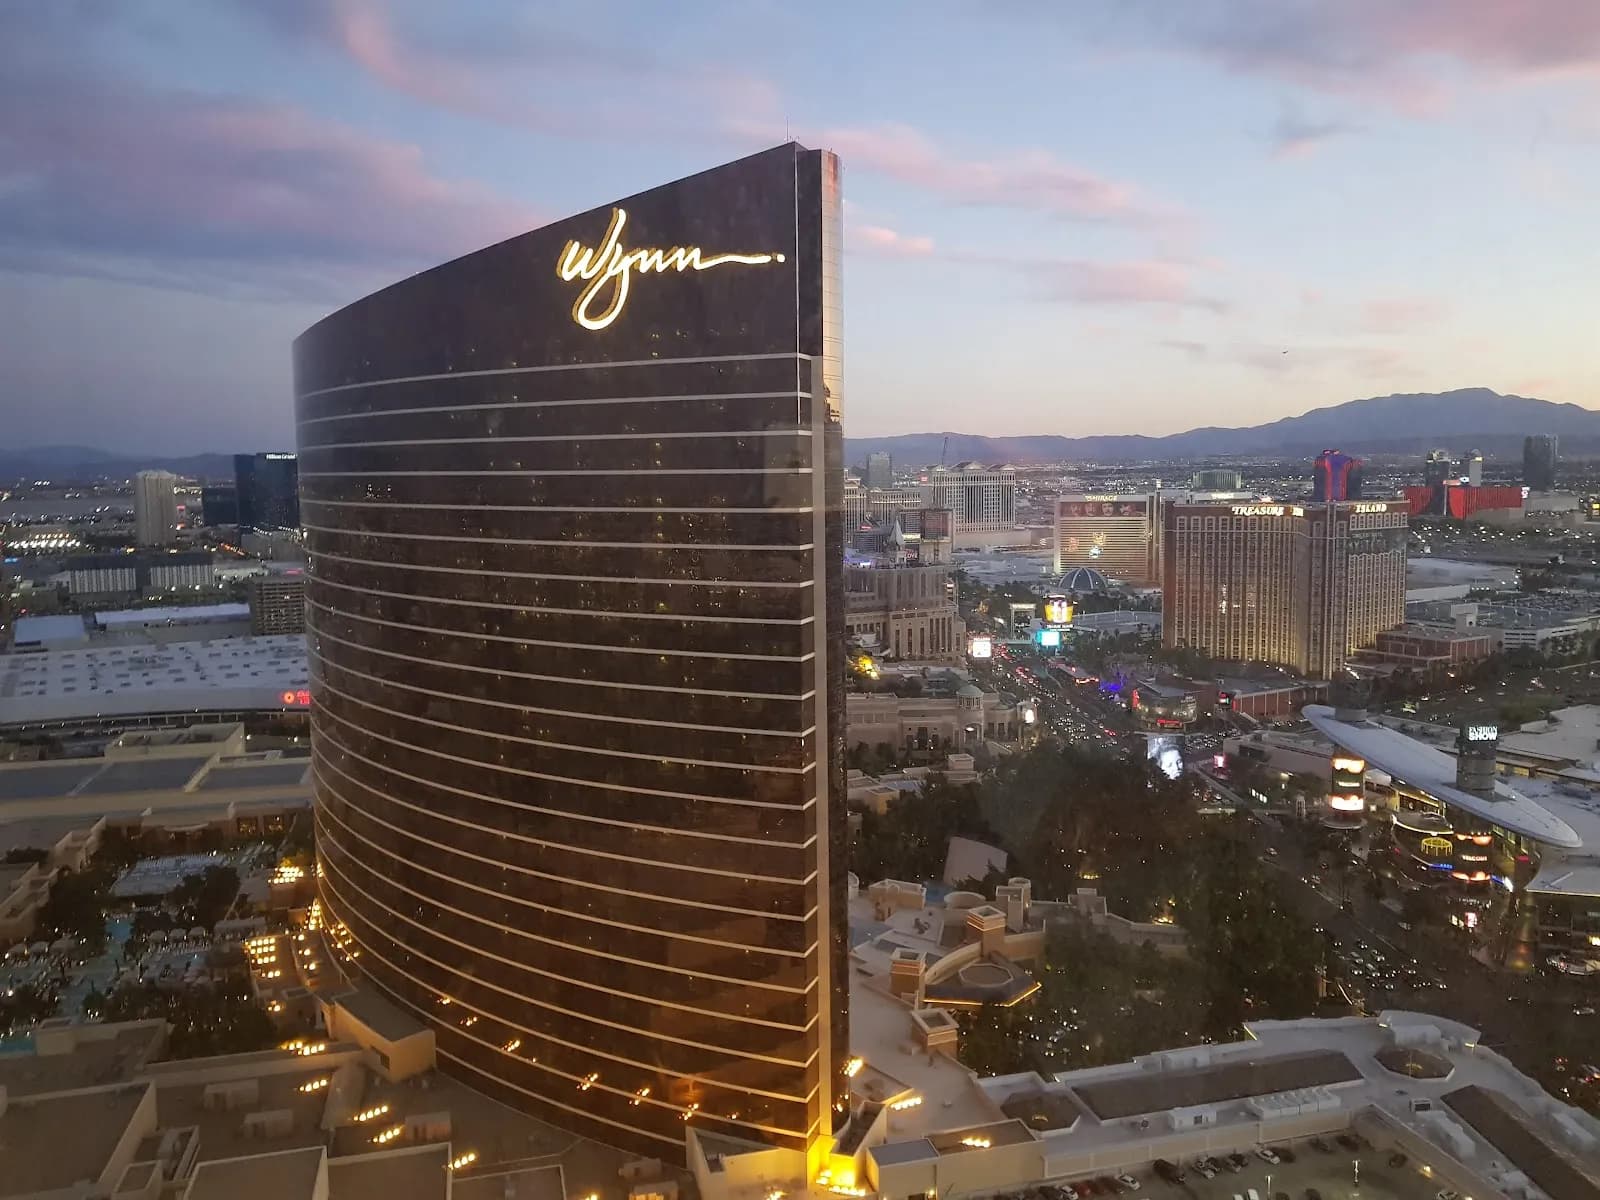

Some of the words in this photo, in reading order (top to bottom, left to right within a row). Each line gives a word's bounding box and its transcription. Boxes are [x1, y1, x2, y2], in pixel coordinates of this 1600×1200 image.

[1231, 506, 1284, 517] TREASURE
[1355, 503, 1387, 513] ISLAND
[1468, 726, 1498, 734] FASHION
[1468, 733, 1498, 741] SHOW
